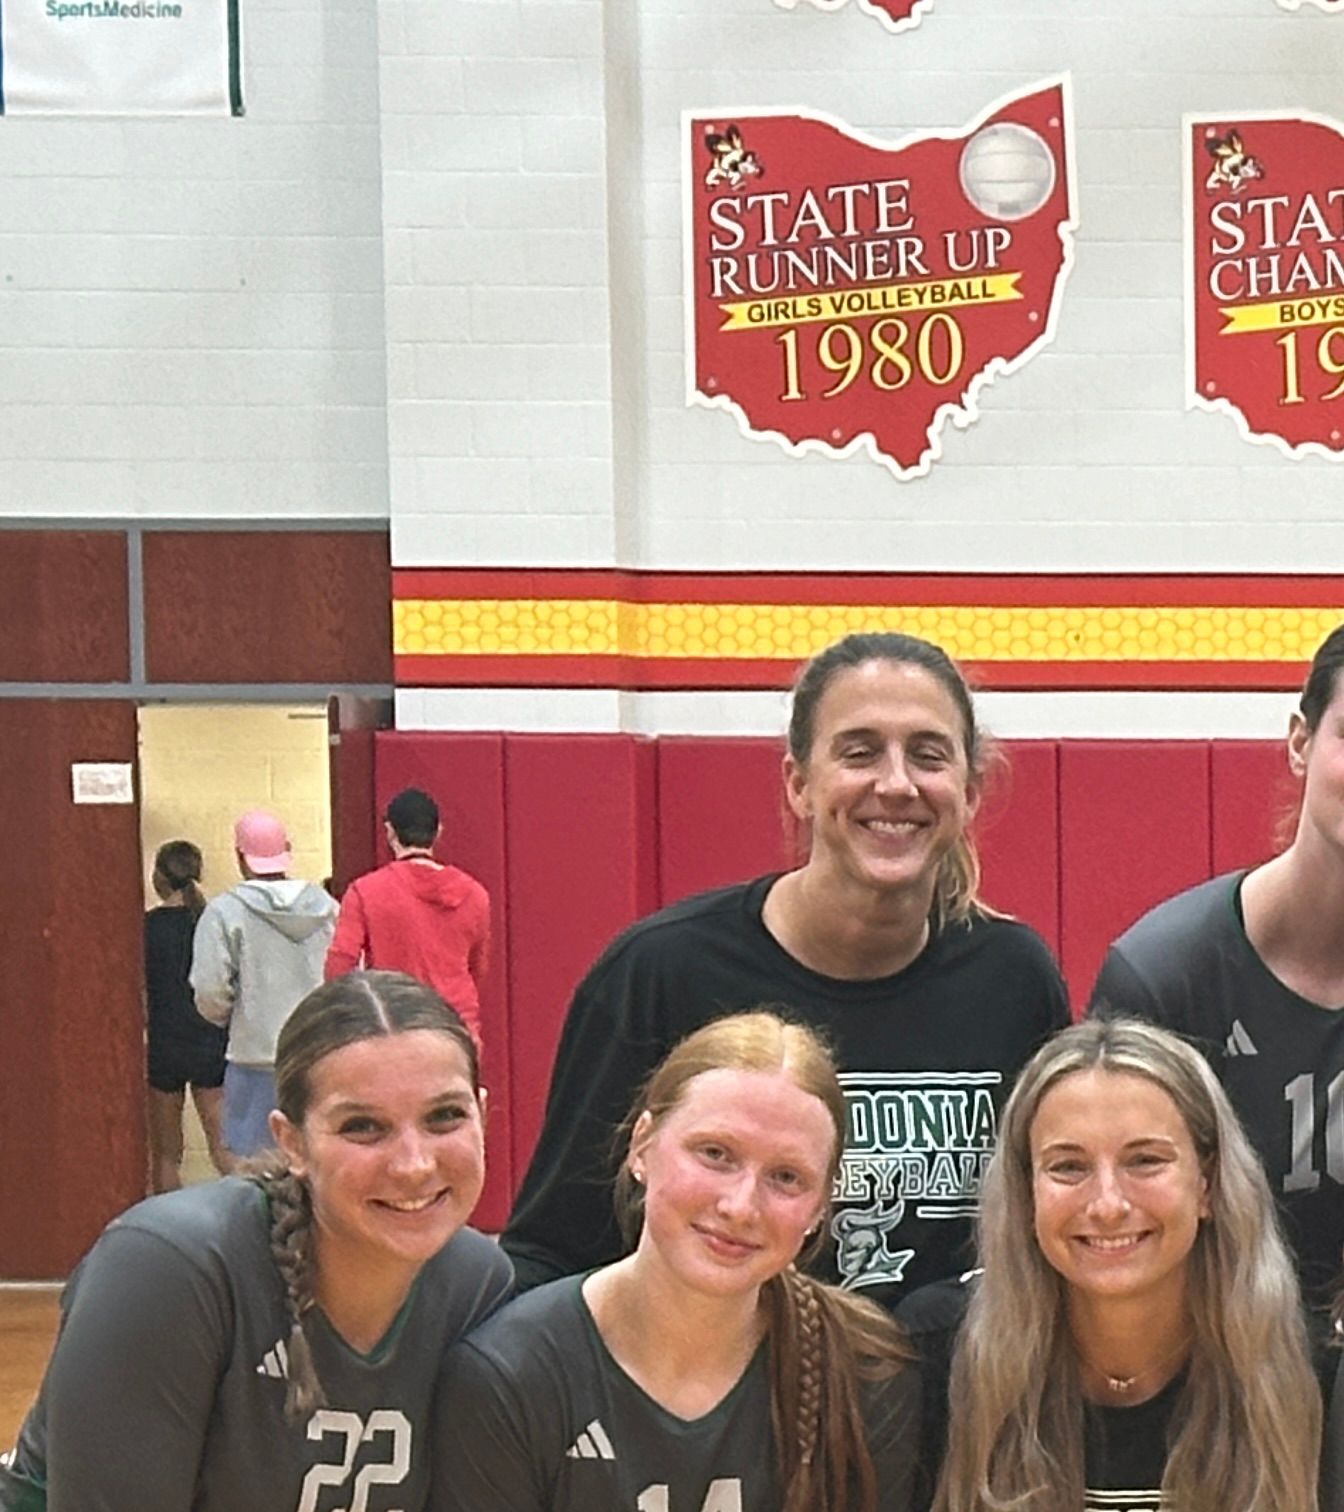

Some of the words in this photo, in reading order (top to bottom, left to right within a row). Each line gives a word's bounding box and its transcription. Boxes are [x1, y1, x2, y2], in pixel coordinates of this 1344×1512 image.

[45, 0, 183, 20] SportsMedicine
[710, 180, 914, 251] STATE
[711, 237, 929, 297] RUNNER
[945, 227, 1011, 271] UP
[748, 299, 822, 324] GIRLS
[831, 280, 995, 313] VOLLEYBALL
[778, 314, 963, 401] 1980
